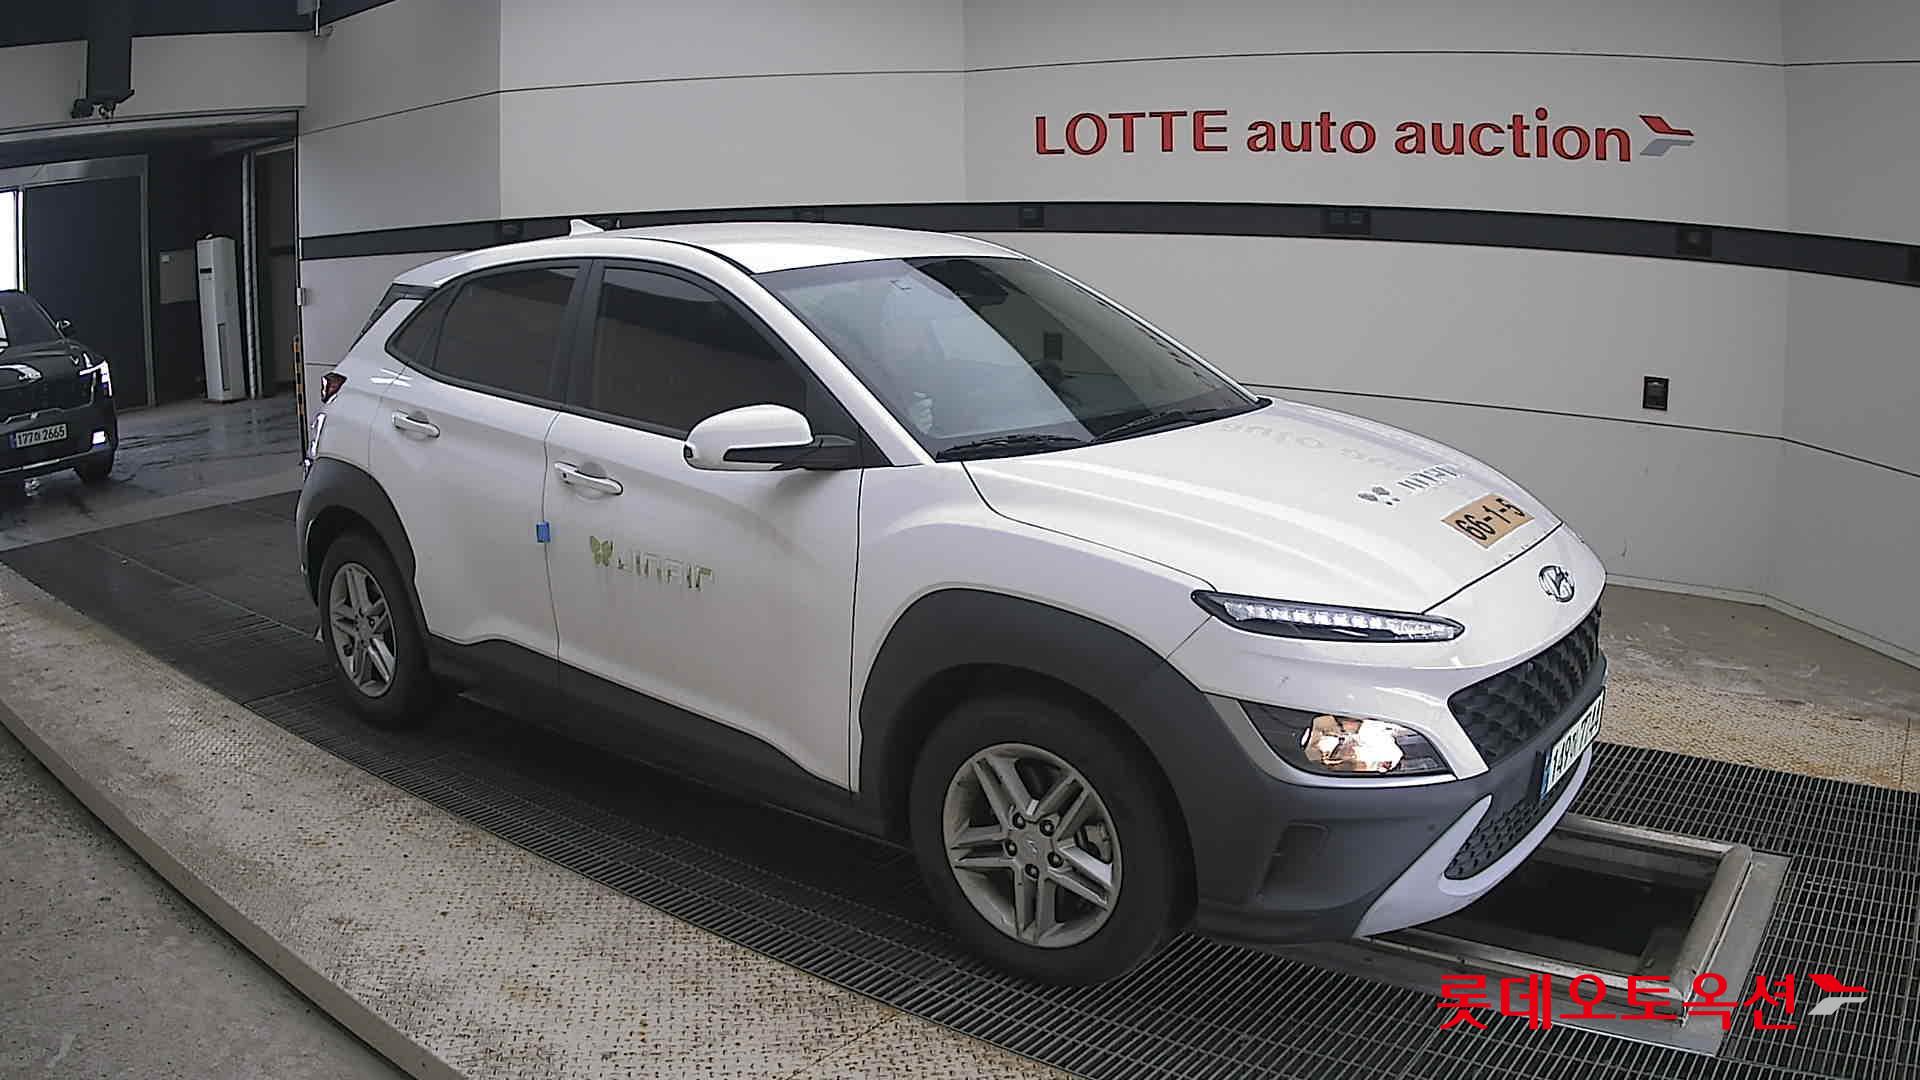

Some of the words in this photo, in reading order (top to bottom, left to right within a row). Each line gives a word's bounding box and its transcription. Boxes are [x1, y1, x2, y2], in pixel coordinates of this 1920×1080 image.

[1036, 109, 1228, 156] LOTTE
[1247, 111, 1378, 154] auto
[1395, 107, 1633, 162] auction
[1454, 497, 1525, 541] 66-1-5
